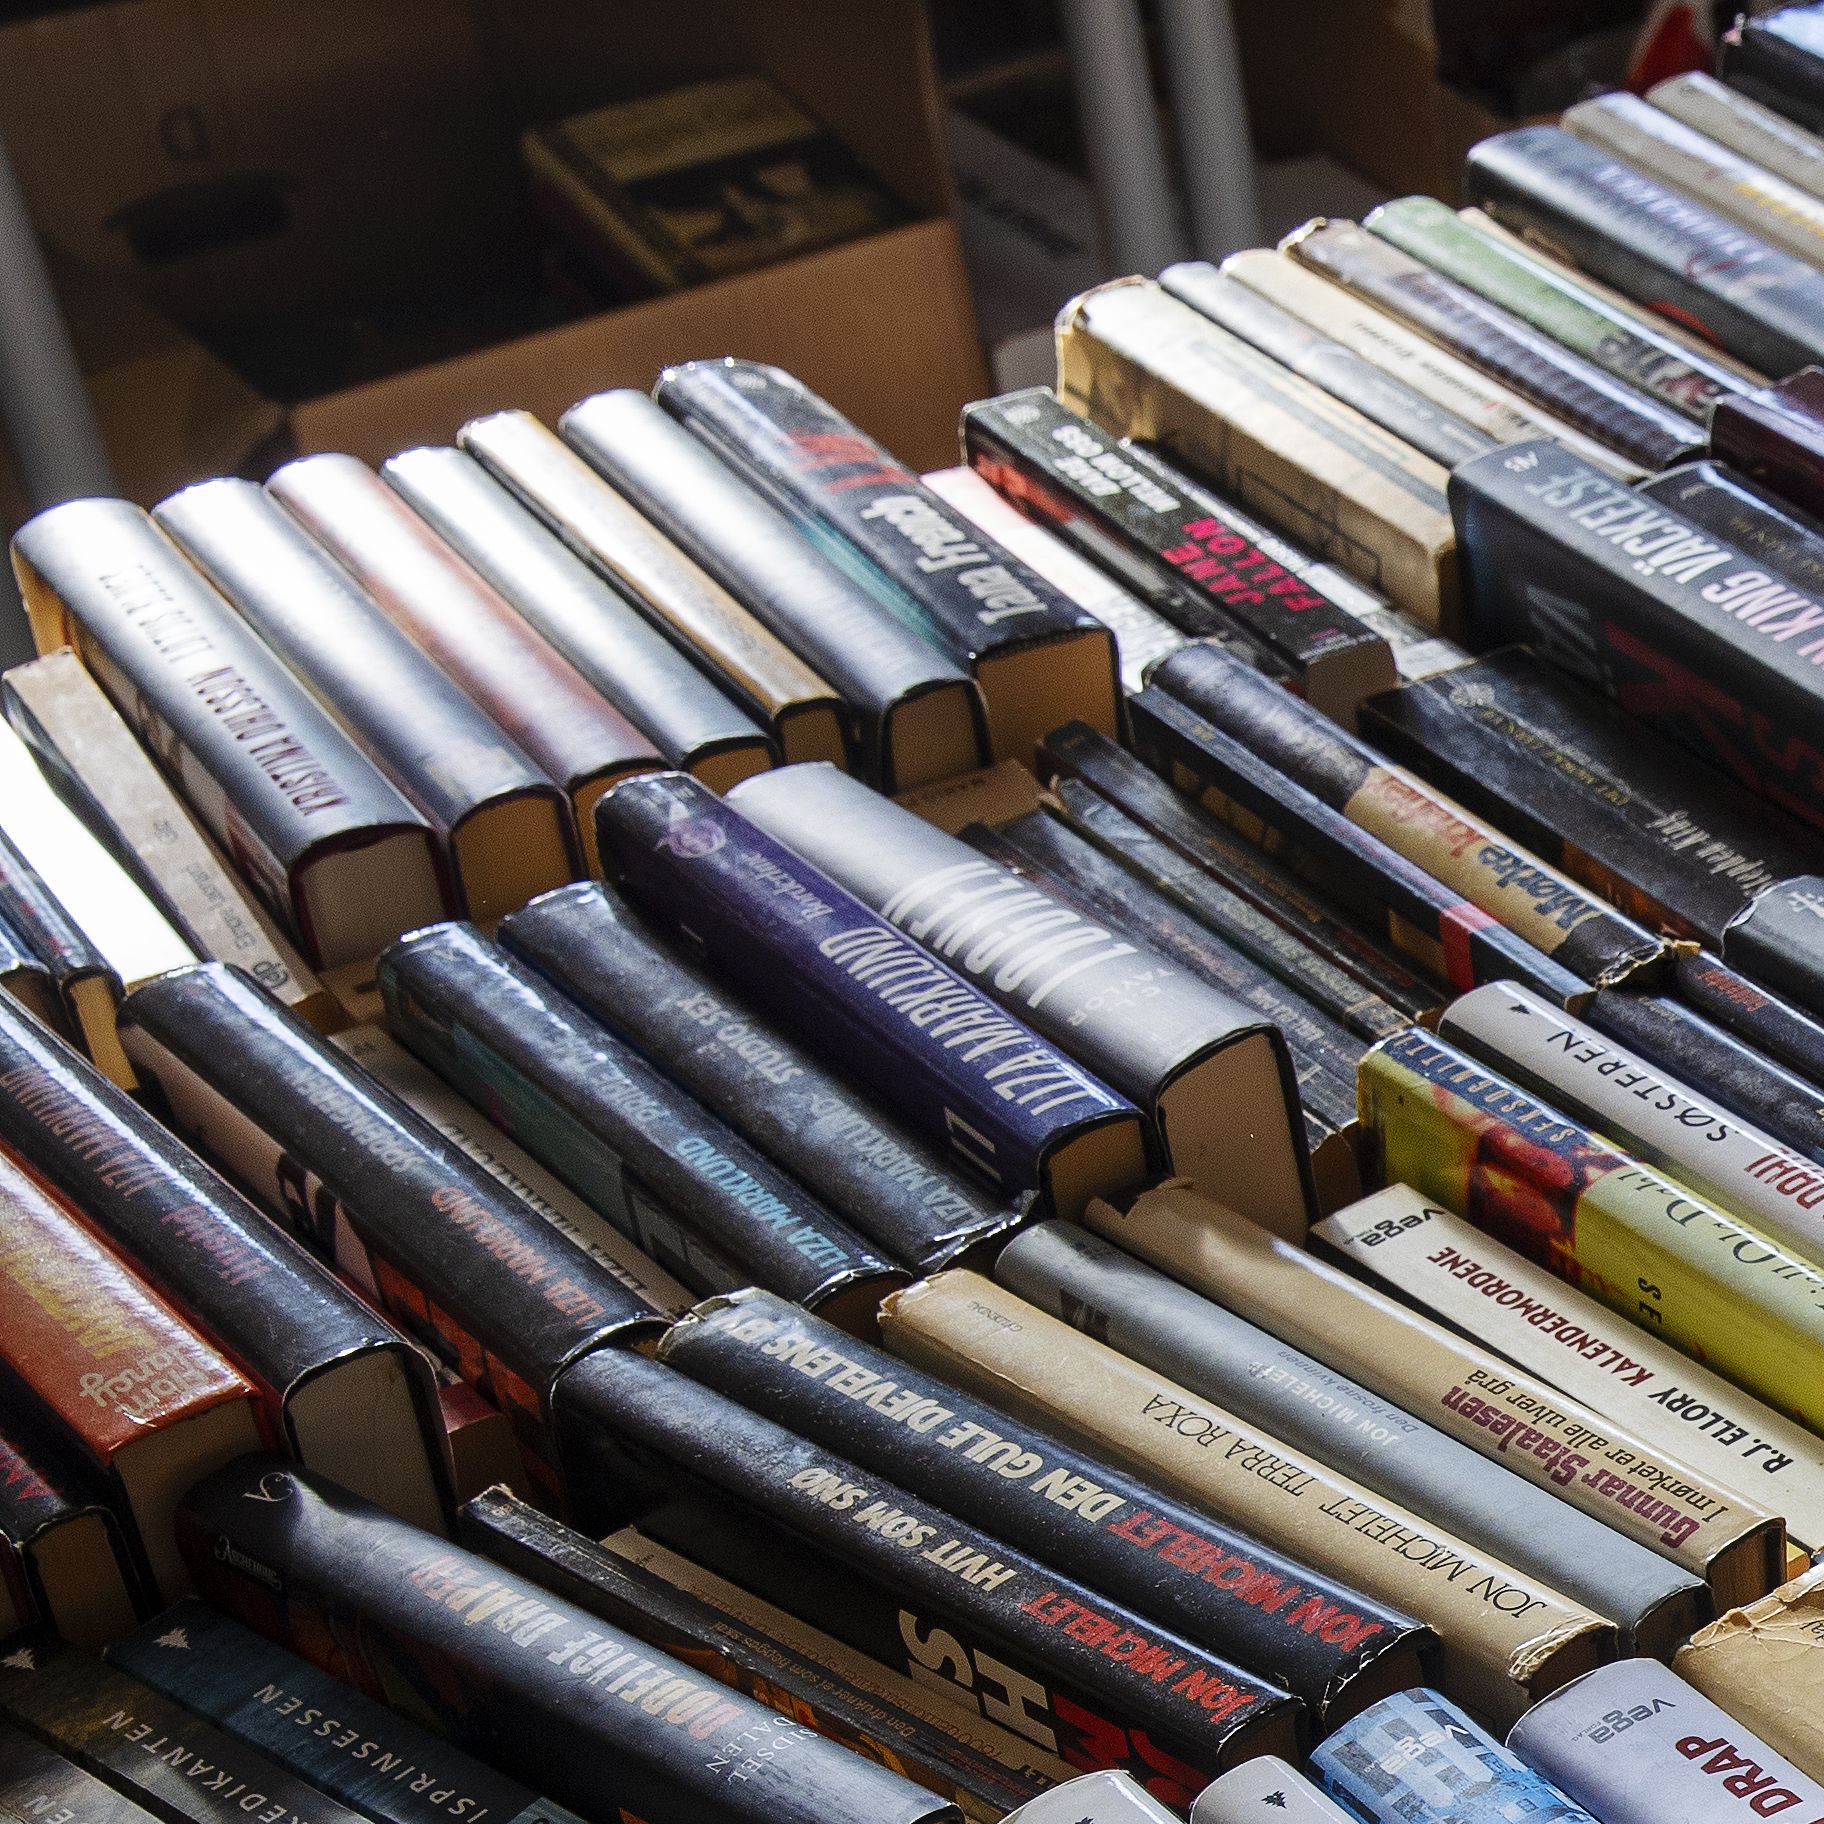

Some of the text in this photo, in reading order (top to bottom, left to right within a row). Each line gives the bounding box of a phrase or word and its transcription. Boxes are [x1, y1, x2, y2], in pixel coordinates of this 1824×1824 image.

[1544, 1027, 1734, 1145] SØSTEREN
[1425, 1244, 1759, 1452] KALENDERMORDENE ELLORY
